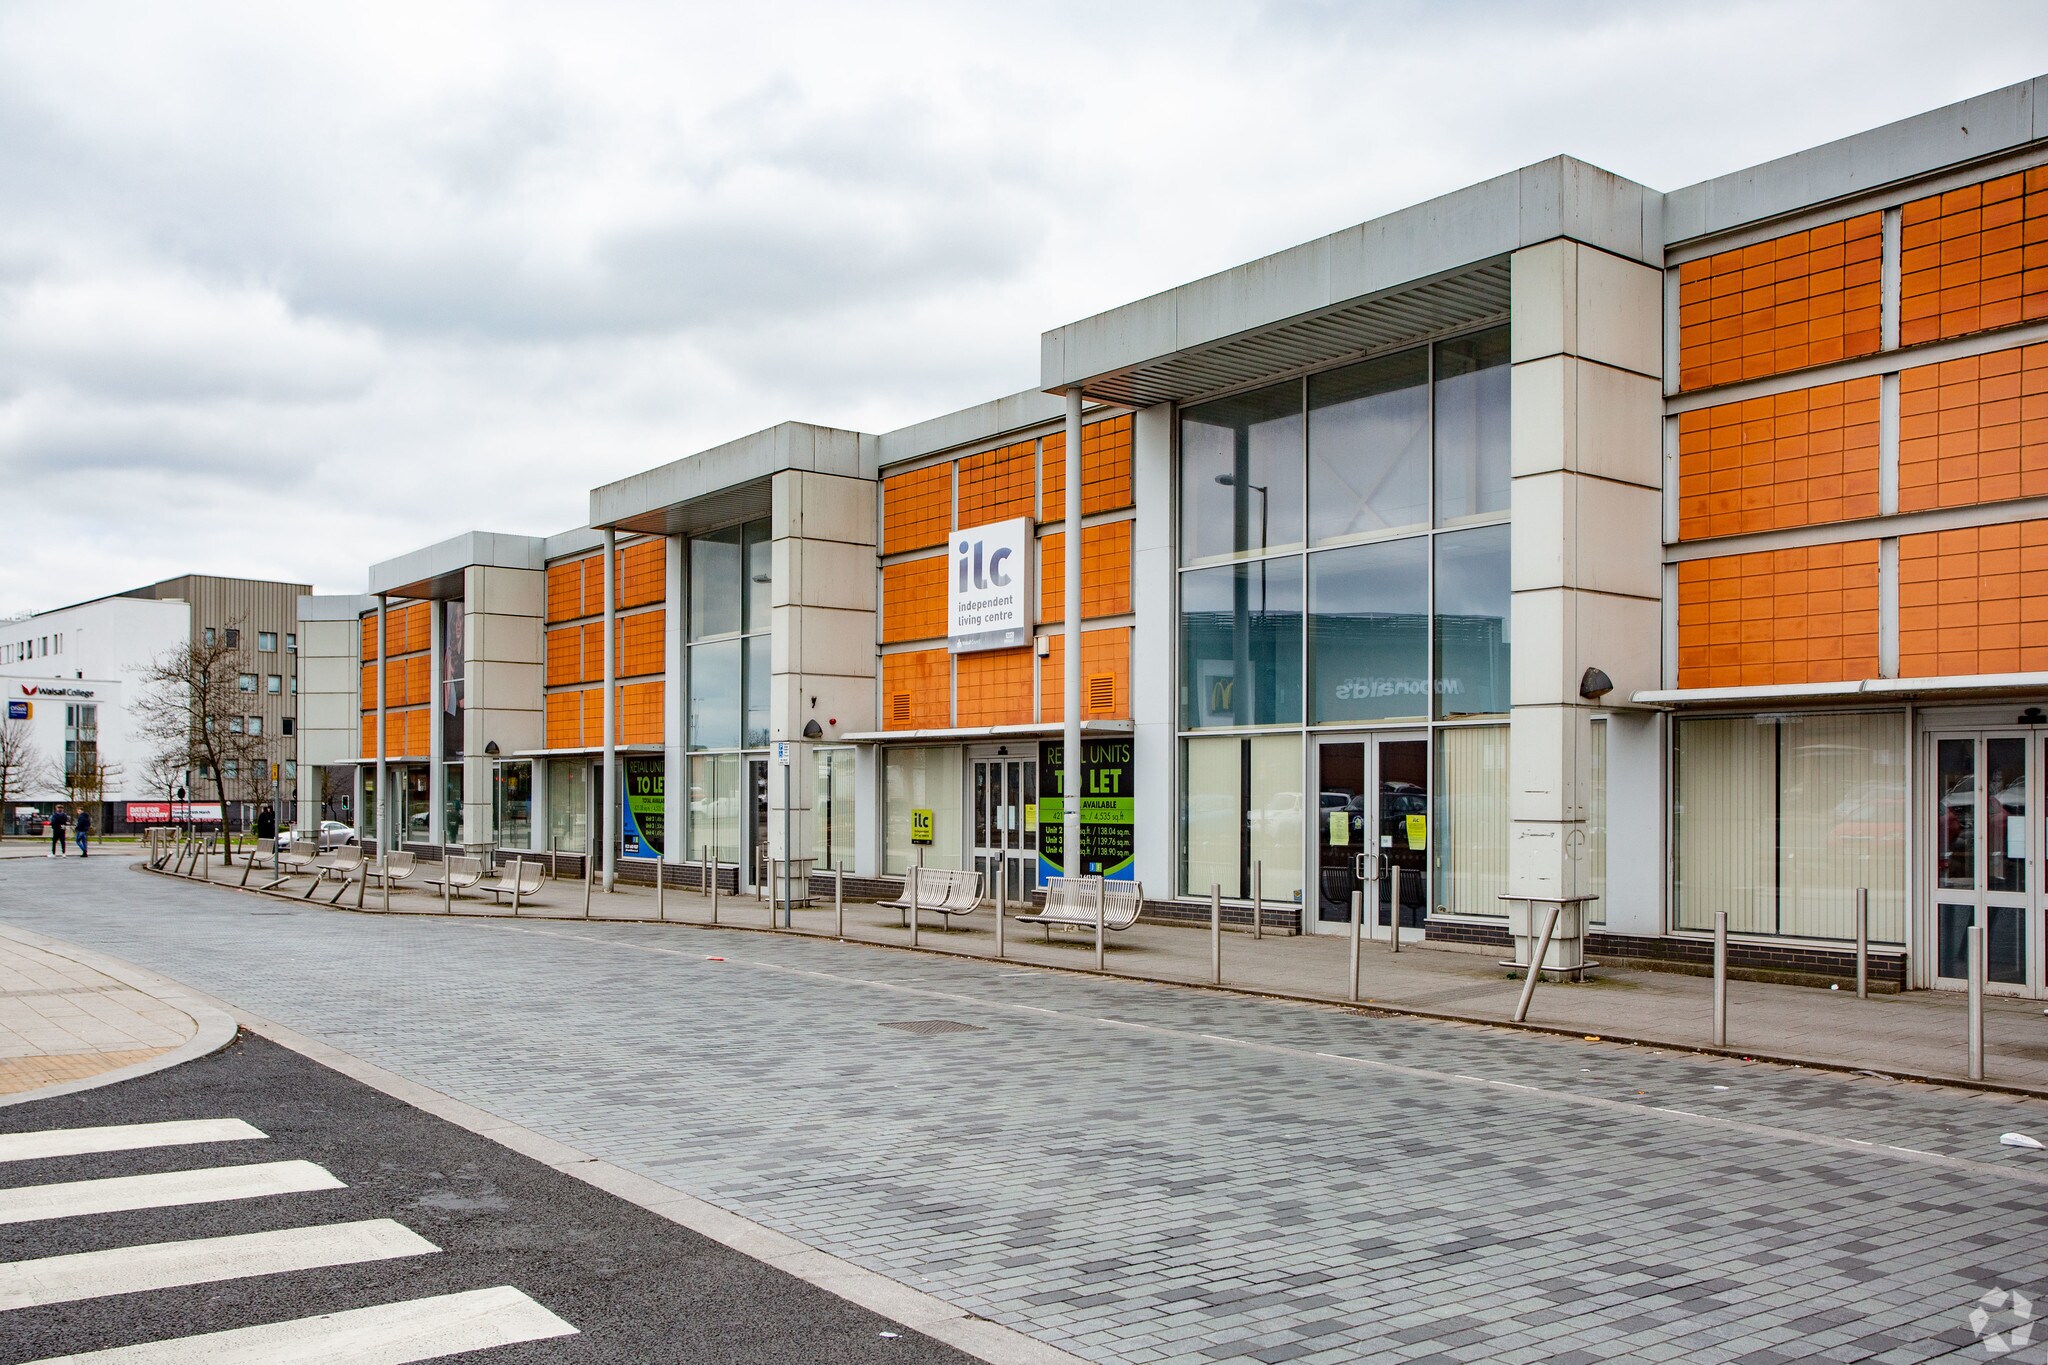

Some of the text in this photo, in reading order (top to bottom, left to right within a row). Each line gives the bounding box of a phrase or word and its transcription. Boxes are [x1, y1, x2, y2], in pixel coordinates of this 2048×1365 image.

[959, 540, 1012, 593] ilc
[958, 594, 1013, 612] independent
[958, 611, 1013, 626] living centre
[39, 687, 95, 698] Walsall College
[1048, 744, 1130, 765] REL UNITS
[650, 761, 665, 773] UNIT
[637, 776, 665, 793] TO LE
[1089, 769, 1122, 793] LET
[914, 812, 929, 828] ilc
[1094, 812, 1110, 821] 4,535
[1045, 826, 1058, 834] Unit
[1097, 827, 1116, 835] 138.04
[1045, 836, 1058, 844] Unit
[1097, 837, 1116, 846] 139.76
[1045, 846, 1058, 854] Unit
[1097, 847, 1117, 856] 138.90
